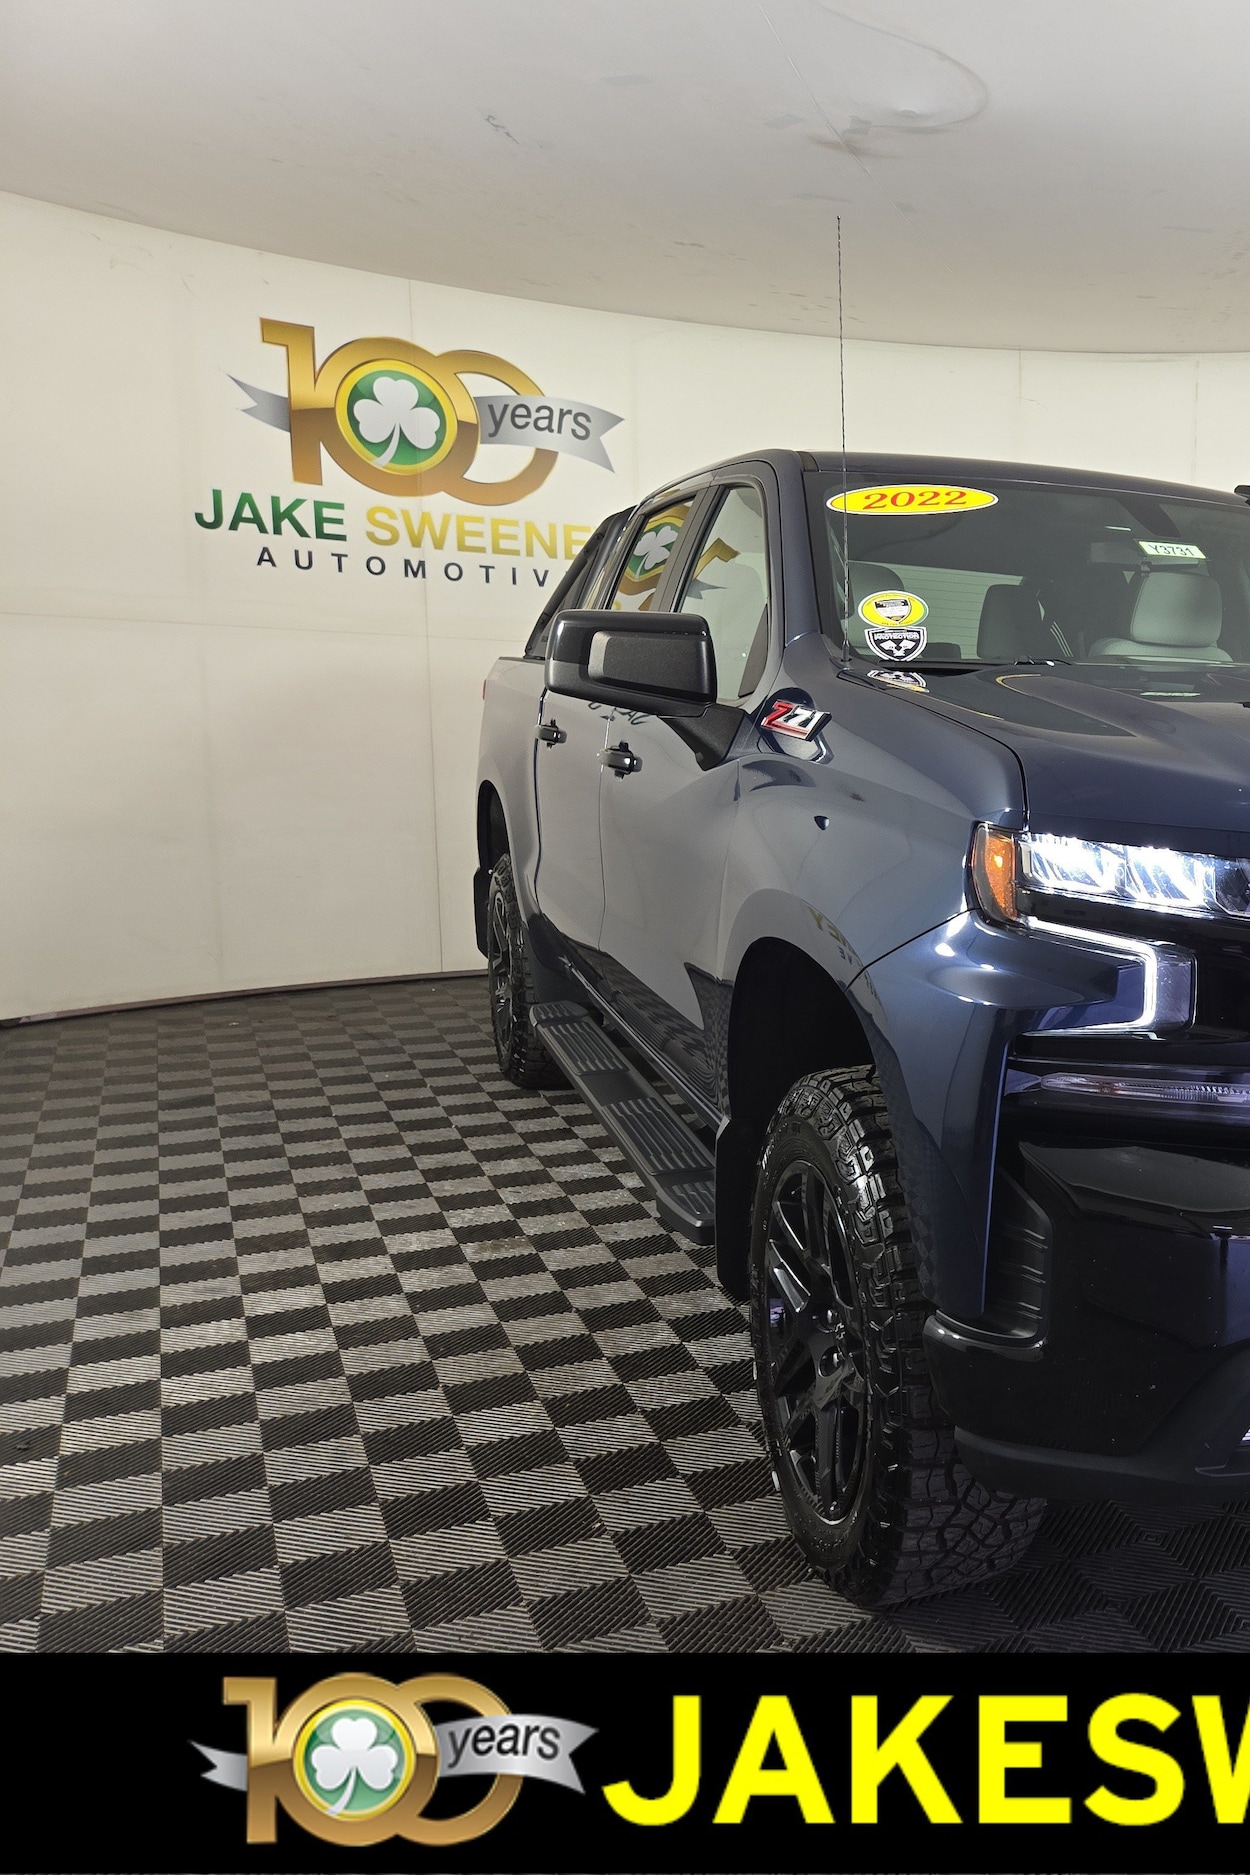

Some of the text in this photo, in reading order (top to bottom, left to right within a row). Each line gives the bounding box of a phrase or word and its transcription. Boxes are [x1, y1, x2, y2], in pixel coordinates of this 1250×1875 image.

[260, 317, 592, 506] 100 years
[862, 490, 967, 510] 2022
[194, 489, 600, 560] JAKE SWEENE
[257, 546, 568, 587] AUTOMOTIV
[1147, 544, 1195, 557] Y3731
[760, 699, 832, 742] Z71
